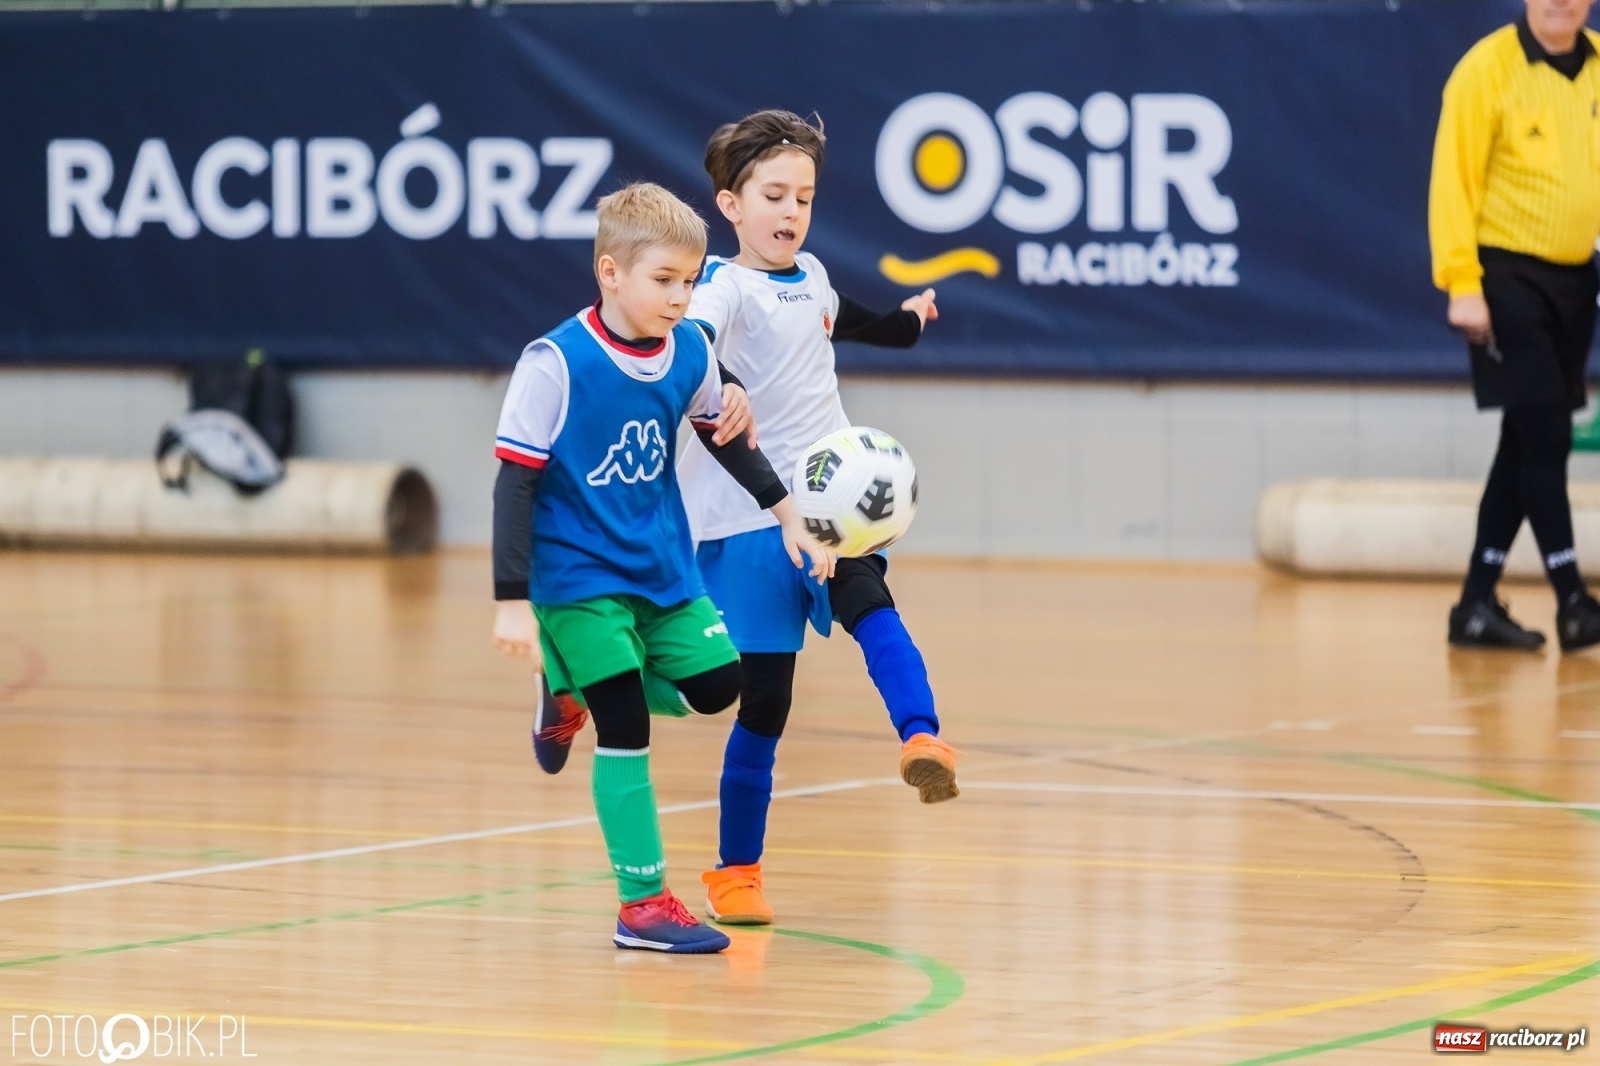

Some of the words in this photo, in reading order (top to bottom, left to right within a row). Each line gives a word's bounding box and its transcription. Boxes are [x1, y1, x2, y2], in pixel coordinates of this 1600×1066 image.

[46, 103, 613, 240] RACIBÓRZ
[875, 91, 1239, 234] OSiR
[1016, 232, 1240, 287] RACIBÓRZ
